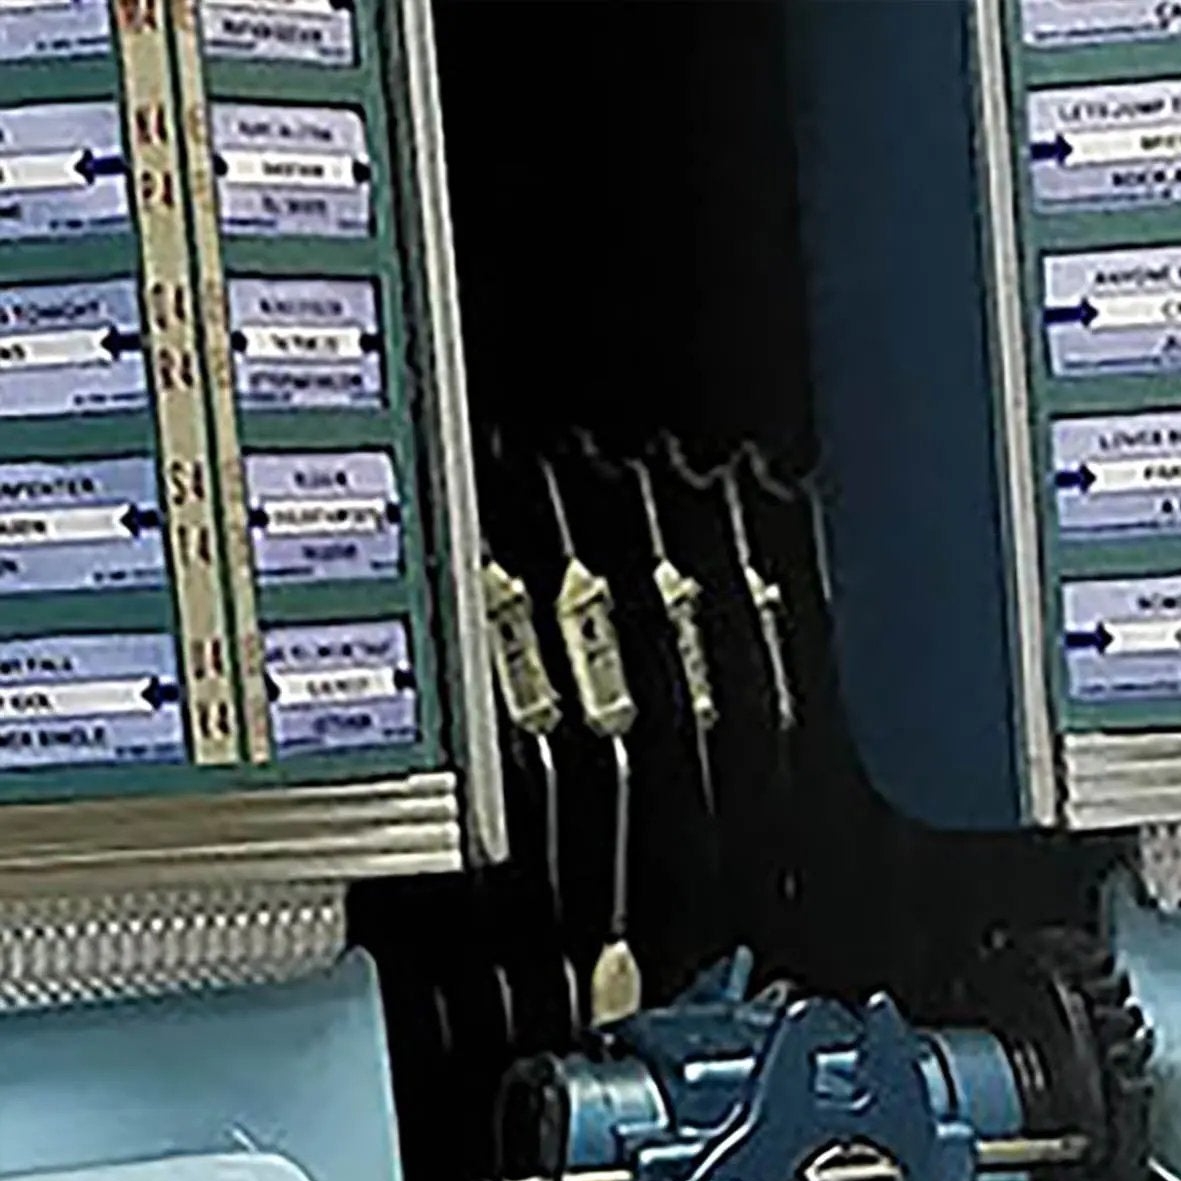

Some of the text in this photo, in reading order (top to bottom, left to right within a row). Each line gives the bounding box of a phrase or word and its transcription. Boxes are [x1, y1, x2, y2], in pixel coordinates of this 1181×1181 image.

[142, 171, 172, 208] P4
[171, 461, 206, 505] S4
[177, 525, 210, 565] T4
